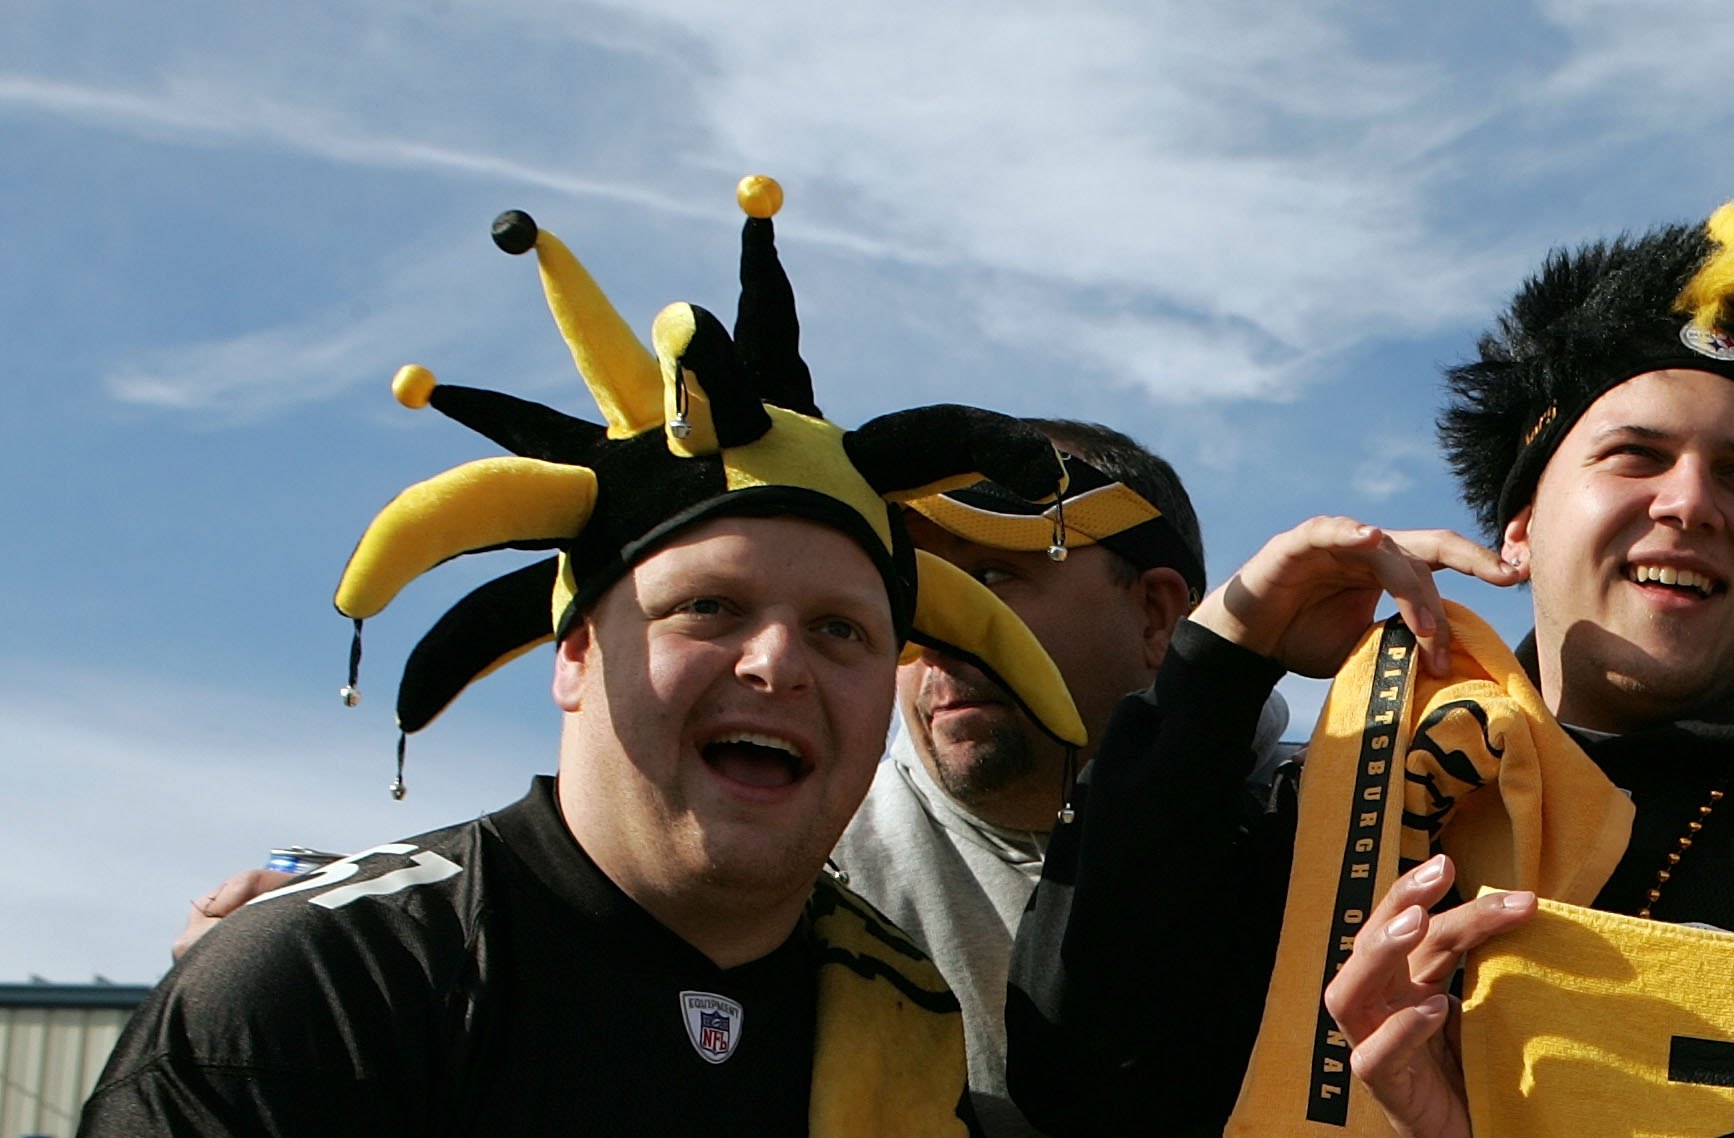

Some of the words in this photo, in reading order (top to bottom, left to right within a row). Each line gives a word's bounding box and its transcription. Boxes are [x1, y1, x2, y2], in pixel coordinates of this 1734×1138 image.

[1351, 646, 1405, 879] PITTSBURGH
[687, 997, 740, 1018] EQUIPMENT
[702, 1028, 728, 1052] NFL
[1320, 909, 1363, 1099] ORNAL
